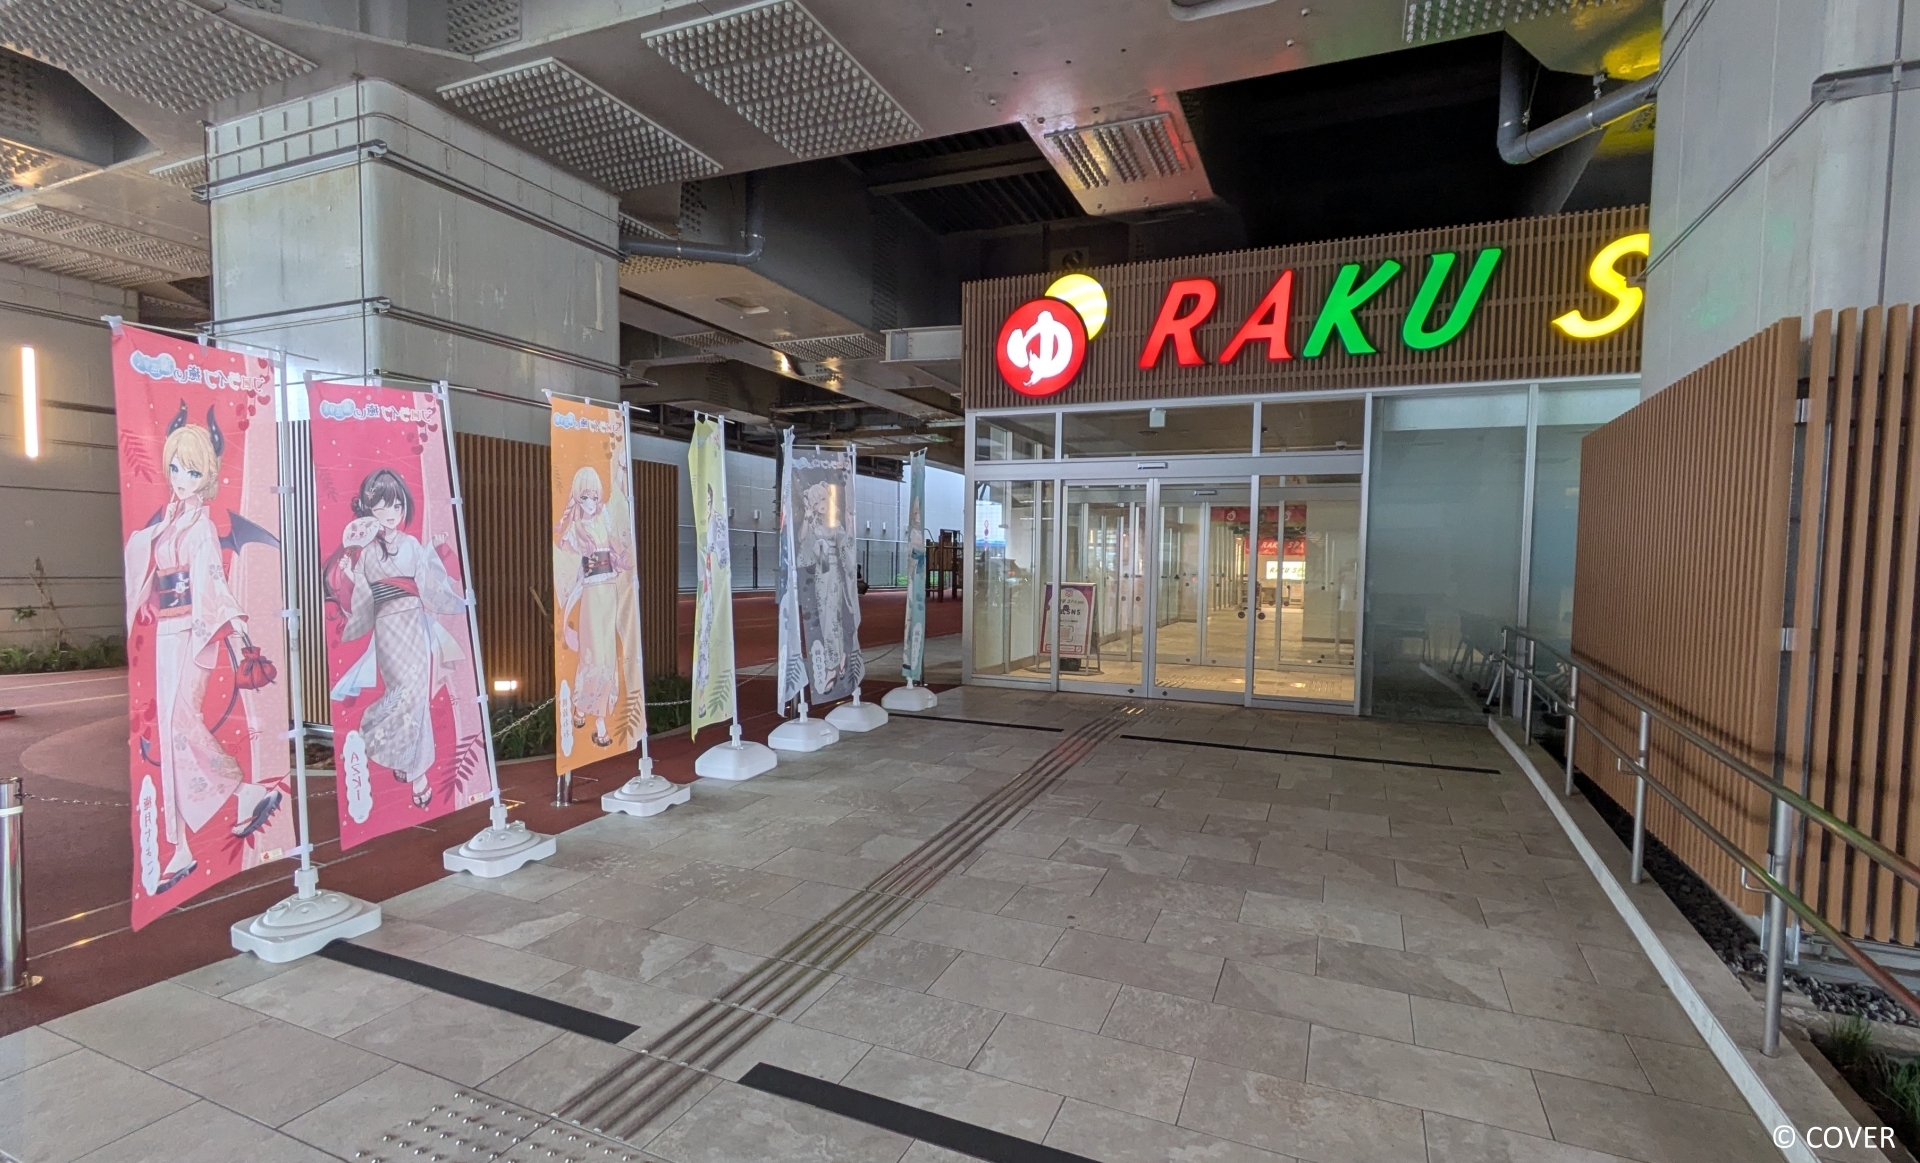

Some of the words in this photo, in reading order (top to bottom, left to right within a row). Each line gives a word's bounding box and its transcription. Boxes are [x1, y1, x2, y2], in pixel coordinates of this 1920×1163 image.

[1139, 247, 1502, 369] RAKU
[1006, 310, 1073, 388] ゆ
[1261, 541, 1279, 549] RAK
